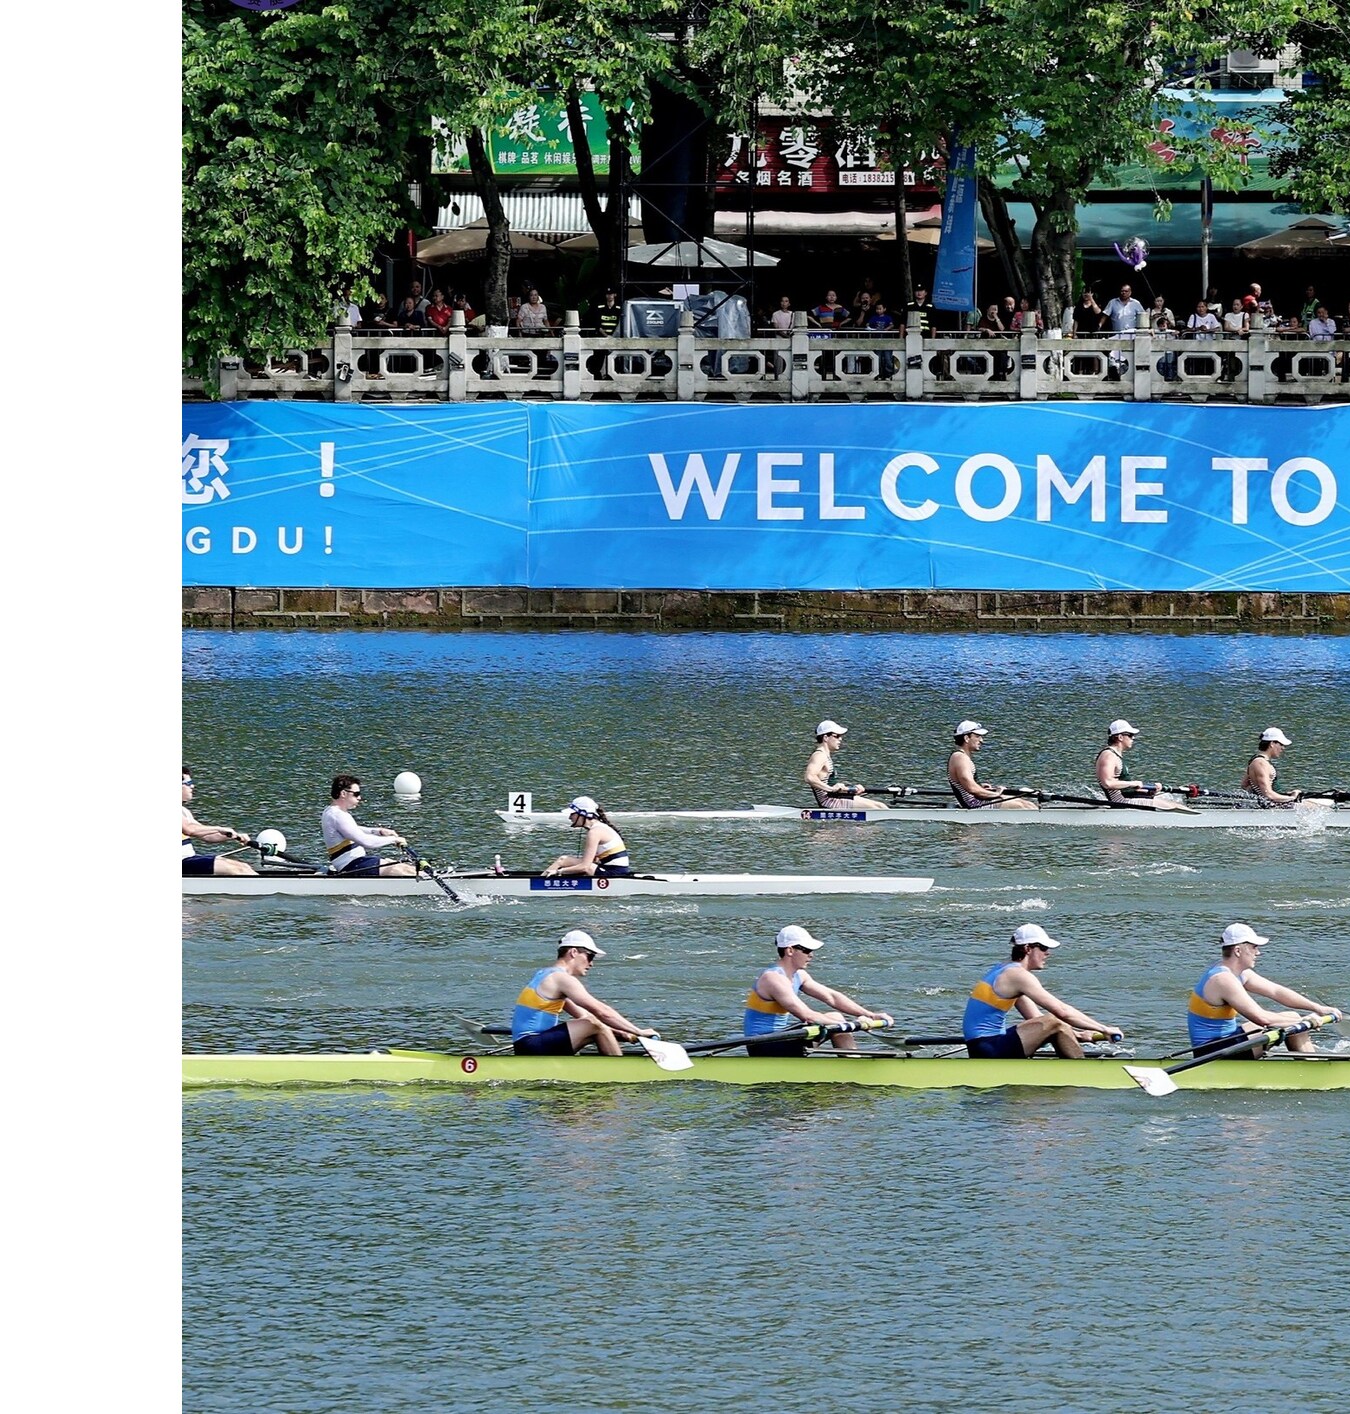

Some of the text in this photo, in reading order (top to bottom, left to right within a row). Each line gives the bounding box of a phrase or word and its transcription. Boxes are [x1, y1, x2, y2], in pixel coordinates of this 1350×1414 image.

[498, 151, 516, 165] 棋牌
[521, 151, 539, 165] 品茗
[648, 452, 1169, 524] WELCOME
[1212, 457, 1337, 526] TO
[185, 526, 333, 554] GDU!
[513, 794, 526, 810] 4
[802, 811, 811, 820] 14
[599, 879, 606, 888] 8
[465, 1059, 475, 1072] 6
